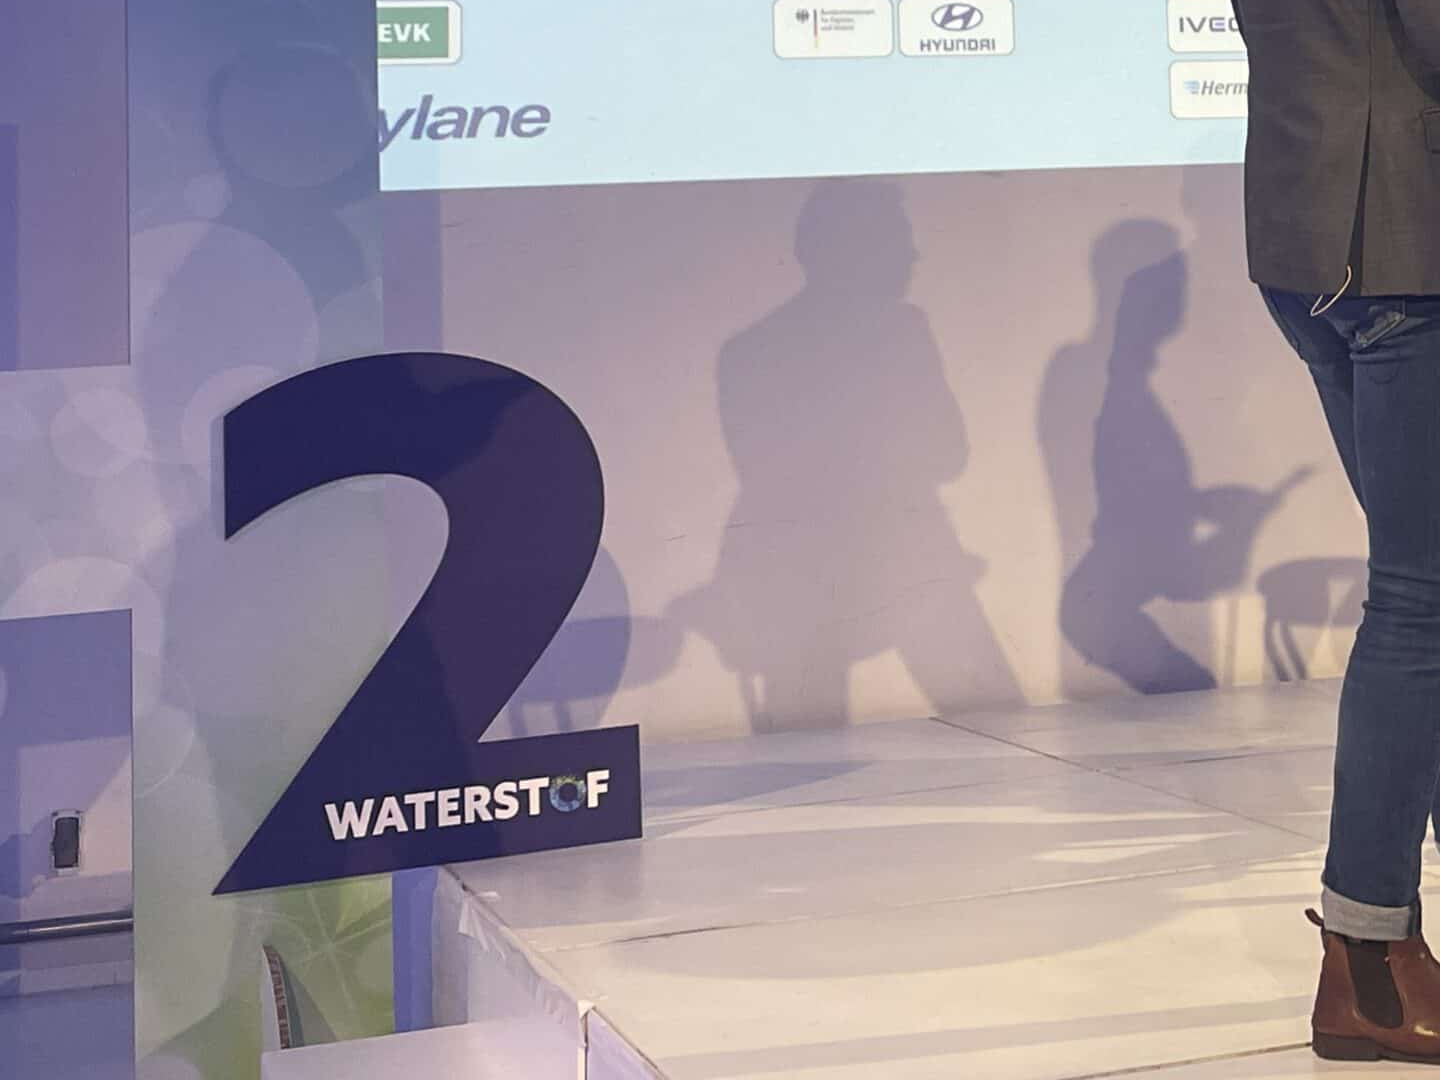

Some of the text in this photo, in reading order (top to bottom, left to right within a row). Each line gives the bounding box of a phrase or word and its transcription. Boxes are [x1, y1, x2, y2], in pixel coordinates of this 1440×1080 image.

[378, 23, 431, 42] EVK
[1179, 16, 1240, 33] IVEC
[919, 38, 996, 52] HYUNDAI
[1201, 80, 1249, 96] Herm
[378, 94, 551, 153] ylane
[324, 769, 611, 840] WATERSTOF
